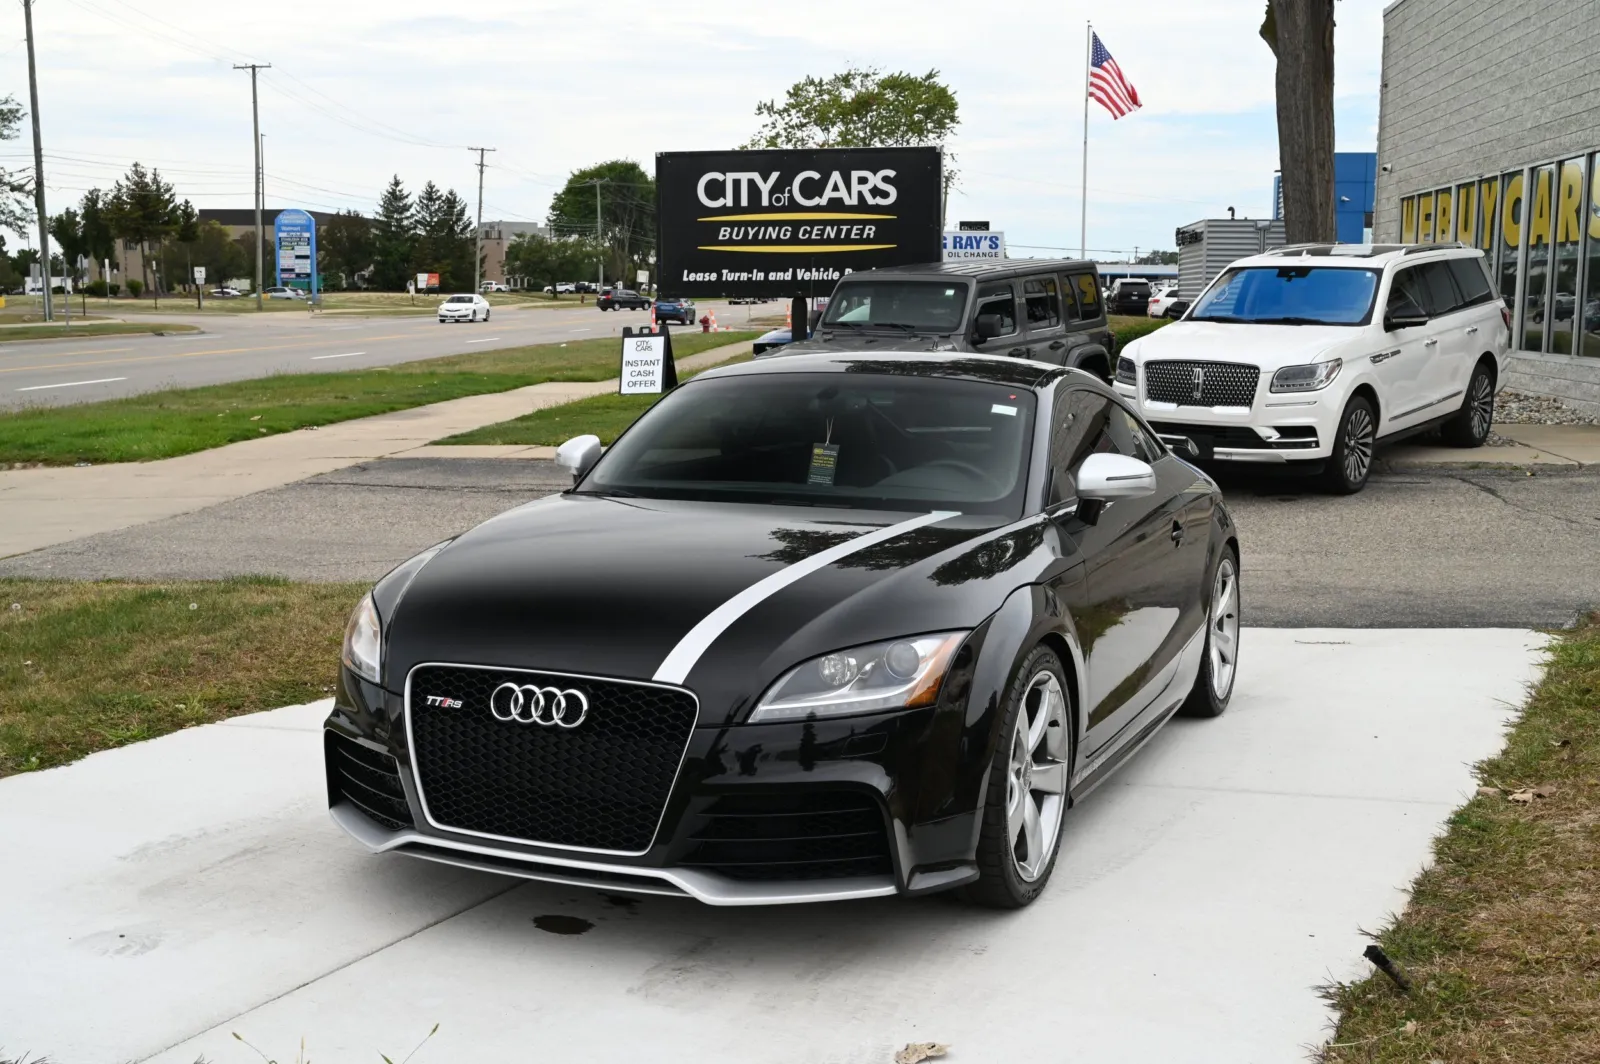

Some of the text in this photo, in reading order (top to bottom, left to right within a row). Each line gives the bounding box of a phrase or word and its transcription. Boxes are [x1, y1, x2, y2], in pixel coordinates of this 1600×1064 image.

[697, 169, 898, 208] CITY of CARS
[718, 225, 876, 240] BUYING CENTER
[953, 235, 999, 250] RAY'S
[683, 269, 717, 281] Lease
[721, 268, 765, 281] Turn-In
[768, 268, 792, 281] and
[796, 267, 840, 280] Vehicle
[625, 359, 661, 367] INSTANT
[630, 370, 655, 378] CASH
[627, 380, 656, 388] OFFER
